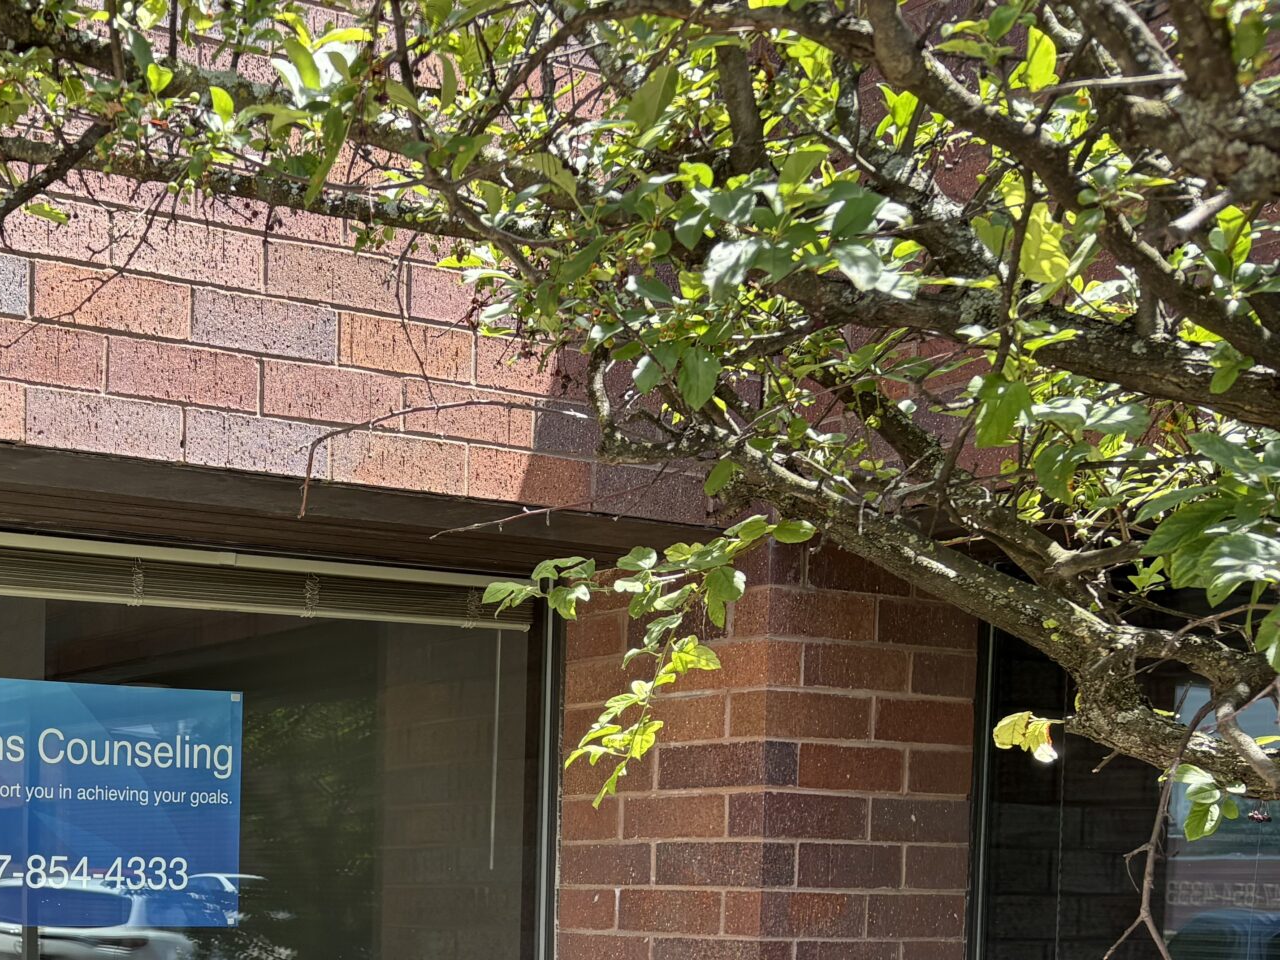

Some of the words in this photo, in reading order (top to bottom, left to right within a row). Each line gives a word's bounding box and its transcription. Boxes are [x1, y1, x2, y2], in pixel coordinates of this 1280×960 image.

[37, 727, 234, 779] Counseling
[25, 785, 54, 802] you
[59, 783, 72, 799] in
[76, 785, 149, 806] achieving
[153, 790, 187, 806] your
[190, 789, 233, 807] goals.
